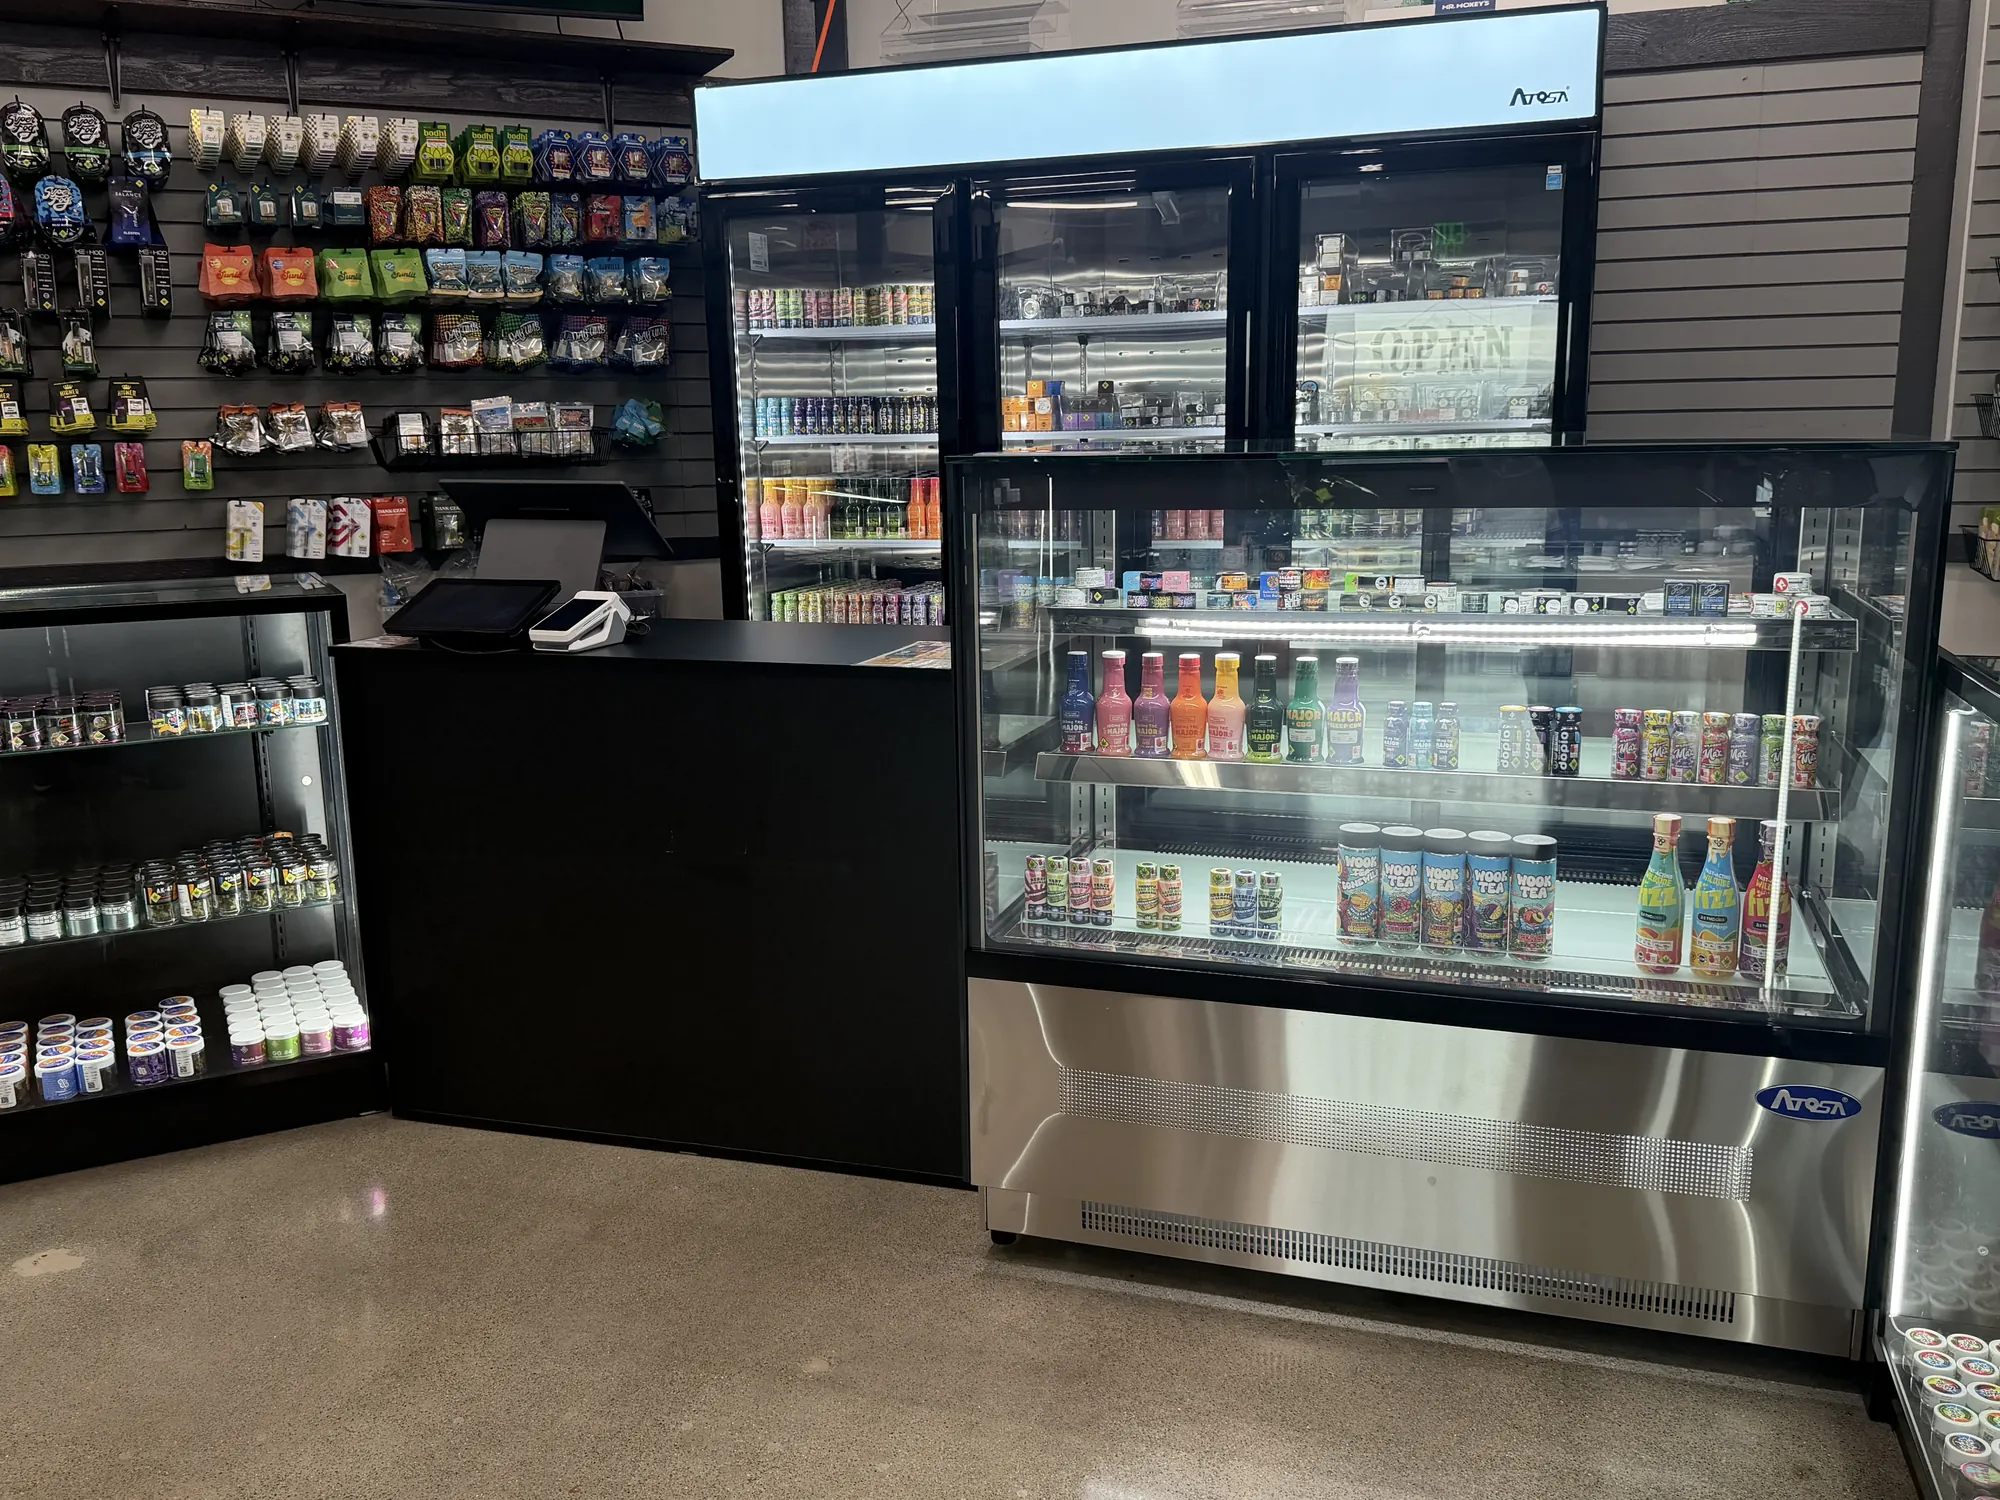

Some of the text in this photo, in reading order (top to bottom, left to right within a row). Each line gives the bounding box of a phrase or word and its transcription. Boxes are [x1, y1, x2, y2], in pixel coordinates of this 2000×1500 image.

[1456, 0, 1490, 8] MOXEY'S
[69, 116, 99, 128] Super
[423, 129, 447, 138] bodhi
[471, 131, 494, 139] bodhi
[507, 131, 528, 140] bodhi
[215, 321, 250, 330] PEAK
[336, 322, 369, 330] PEAK
[1107, 727, 1128, 735] MAJOR
[1500, 730, 1511, 768] dopio
[1559, 731, 1569, 770] dopio
[1344, 855, 1377, 868] WOOK
[1385, 863, 1418, 876] WOOK
[1425, 865, 1459, 880] WOOK
[1474, 869, 1508, 882] WOOK
[1388, 875, 1414, 888] TEA
[1428, 879, 1455, 892] TEA
[1516, 873, 1552, 887] WOOK
[1478, 881, 1504, 894] TEA
[1520, 886, 1548, 899] TEA
[1695, 881, 1736, 910] fizz
[1770, 1088, 1847, 1116] ATOSA
